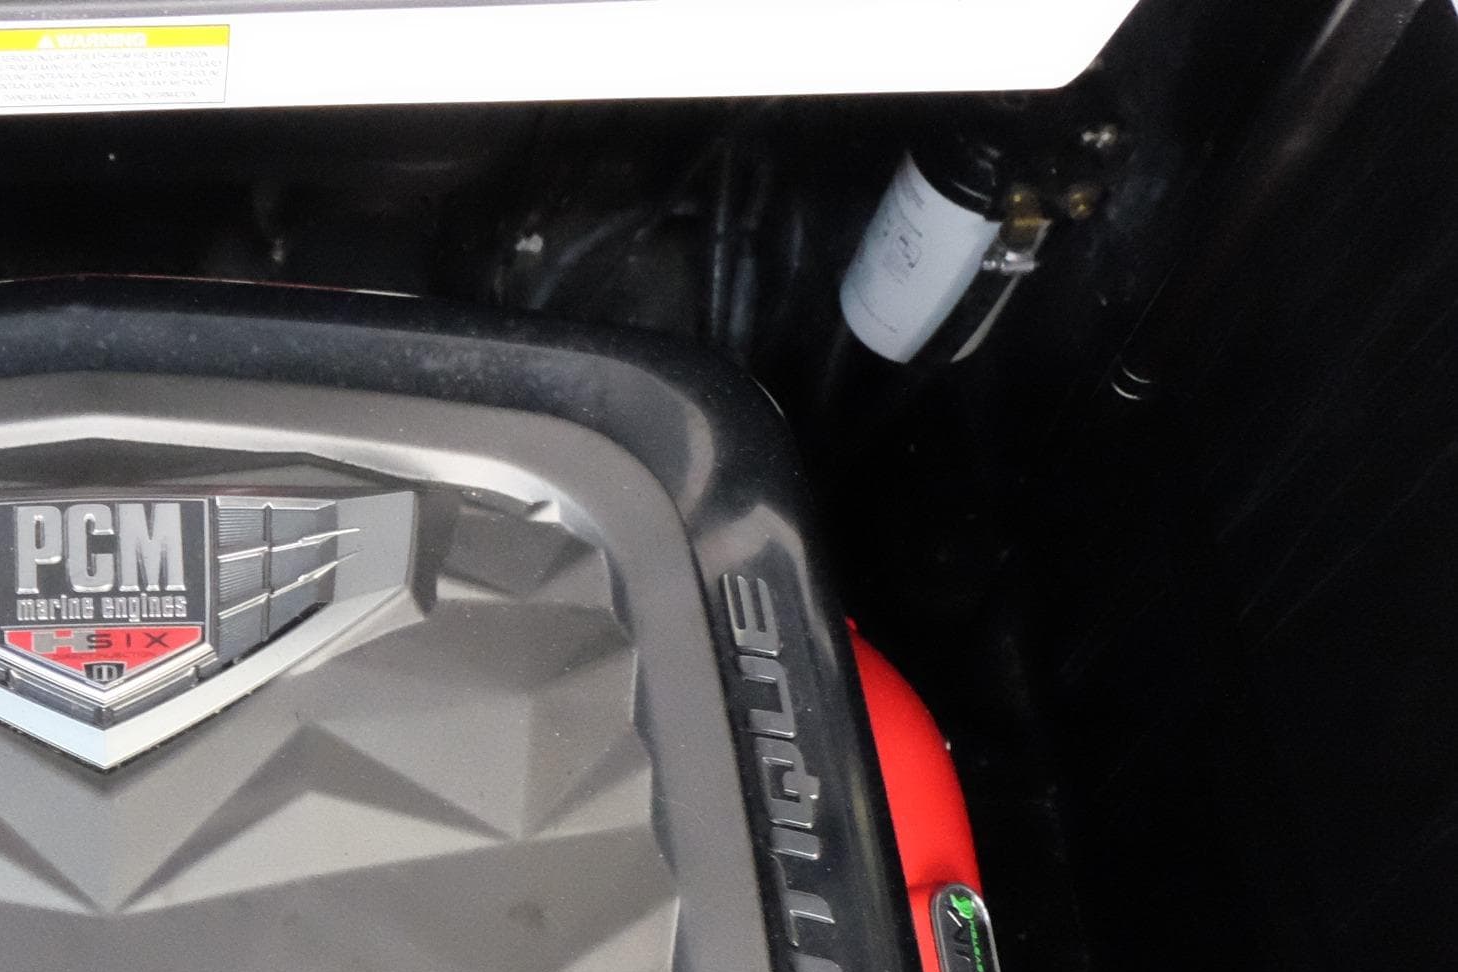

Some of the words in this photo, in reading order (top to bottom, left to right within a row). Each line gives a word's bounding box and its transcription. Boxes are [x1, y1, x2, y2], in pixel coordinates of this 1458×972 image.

[15, 503, 187, 594] PCM
[17, 594, 94, 621] marine
[101, 593, 187, 622] engines
[968, 919, 985, 972] SYSTEM
